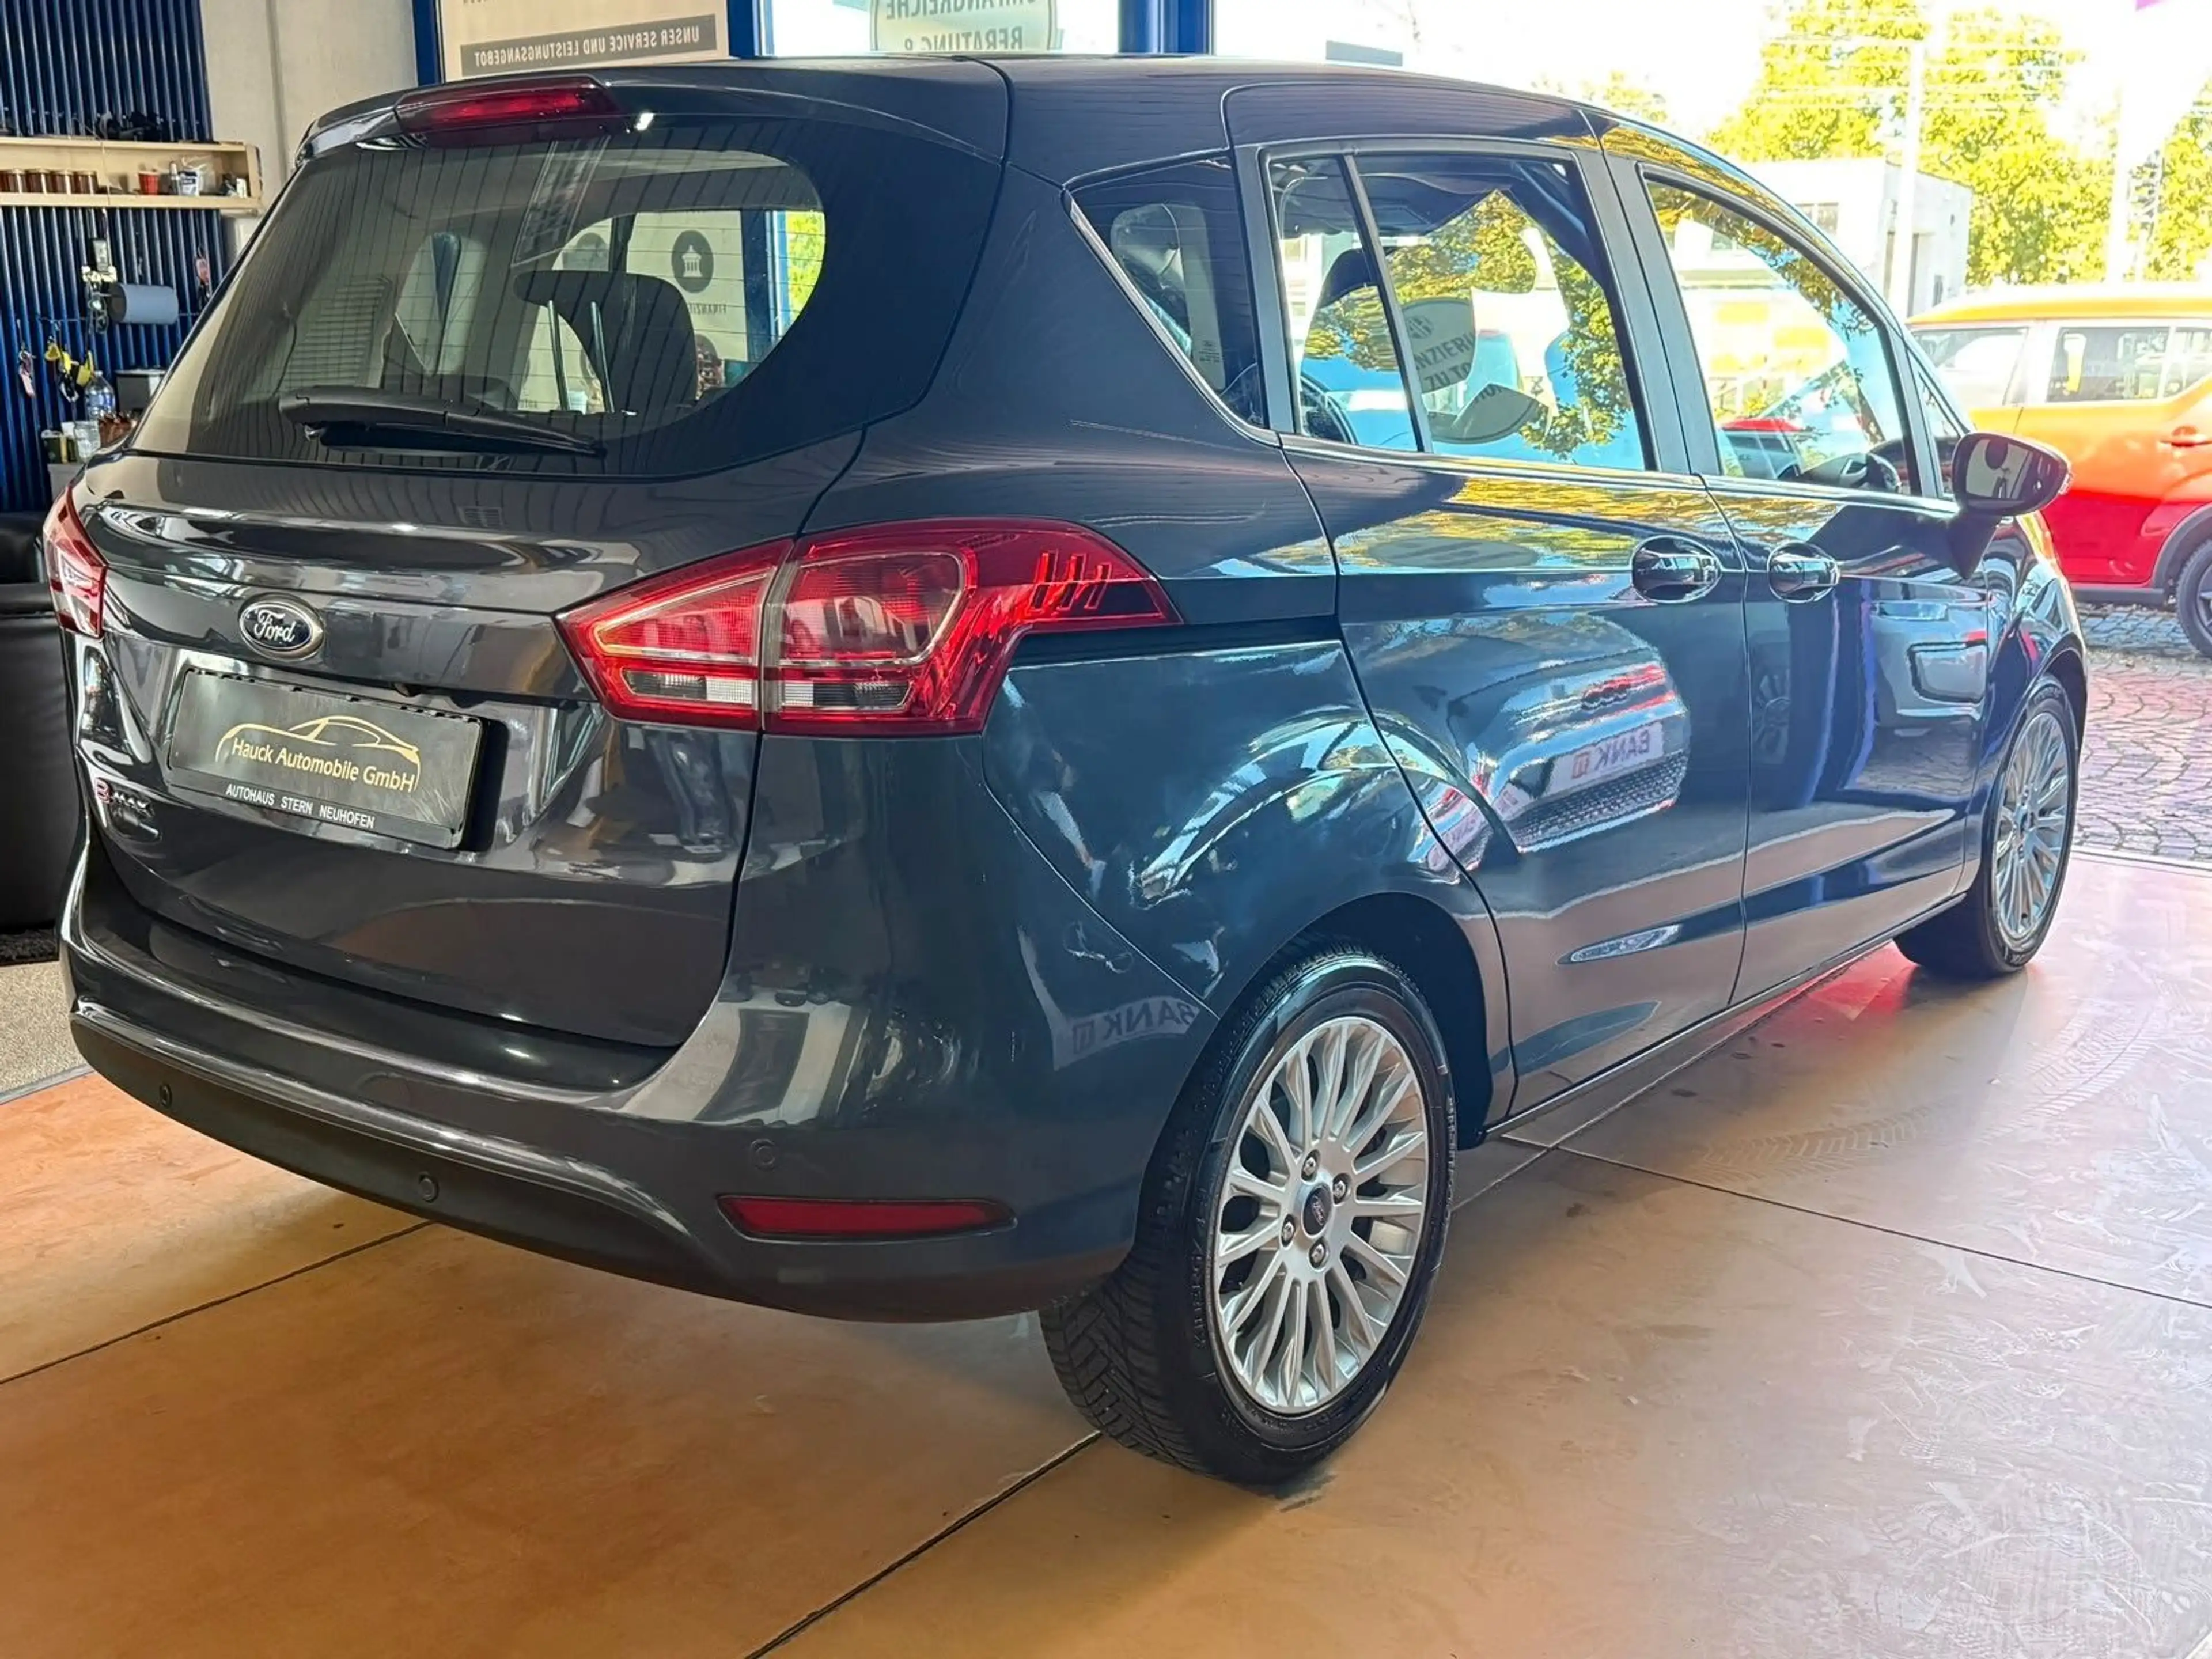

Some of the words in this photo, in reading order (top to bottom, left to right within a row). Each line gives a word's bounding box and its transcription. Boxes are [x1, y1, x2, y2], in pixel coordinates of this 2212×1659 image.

[253, 609, 297, 642] Ford
[232, 738, 273, 764] Hauck
[275, 748, 359, 781] Automobile
[362, 766, 415, 793] GmbH
[225, 783, 275, 806] AUTOHAUS
[281, 796, 314, 817] STERN
[319, 804, 376, 829] NEUHOFEN
